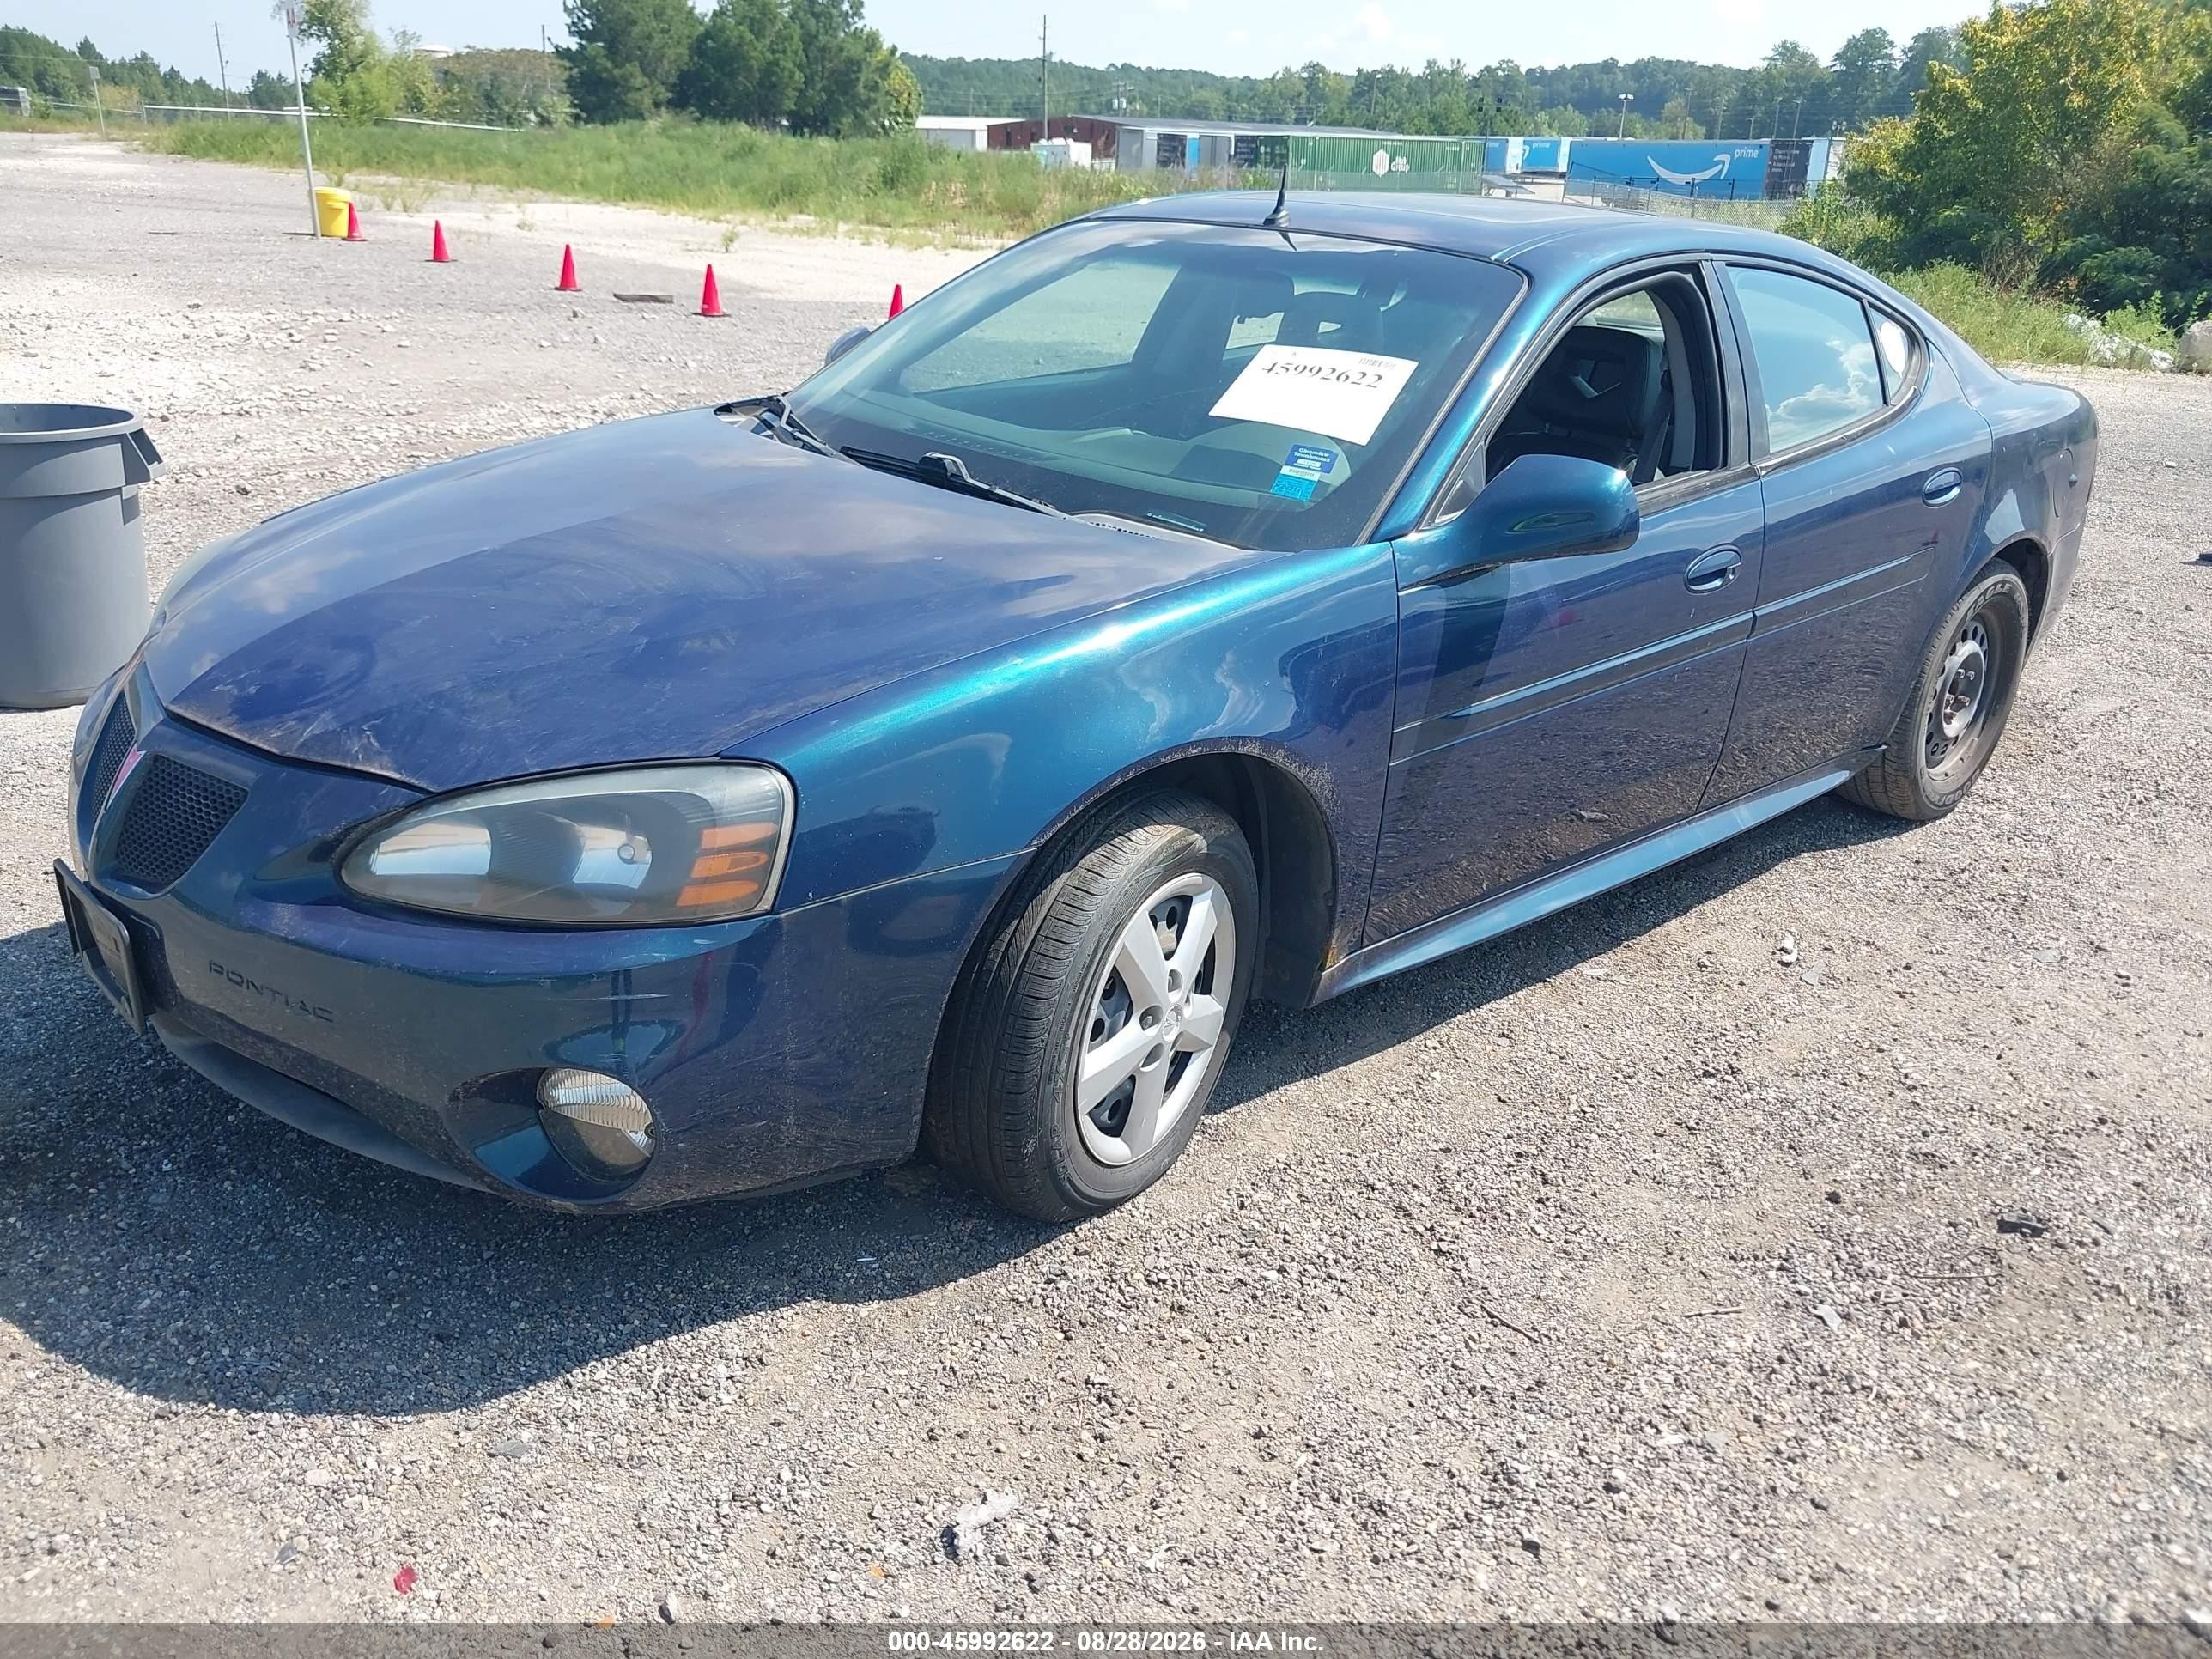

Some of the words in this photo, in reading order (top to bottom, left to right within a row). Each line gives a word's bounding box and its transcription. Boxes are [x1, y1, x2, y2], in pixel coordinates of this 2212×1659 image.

[1734, 146, 1759, 160] prime
[1261, 362, 1383, 389] 45992622
[209, 959, 335, 1023] PONTIAC
